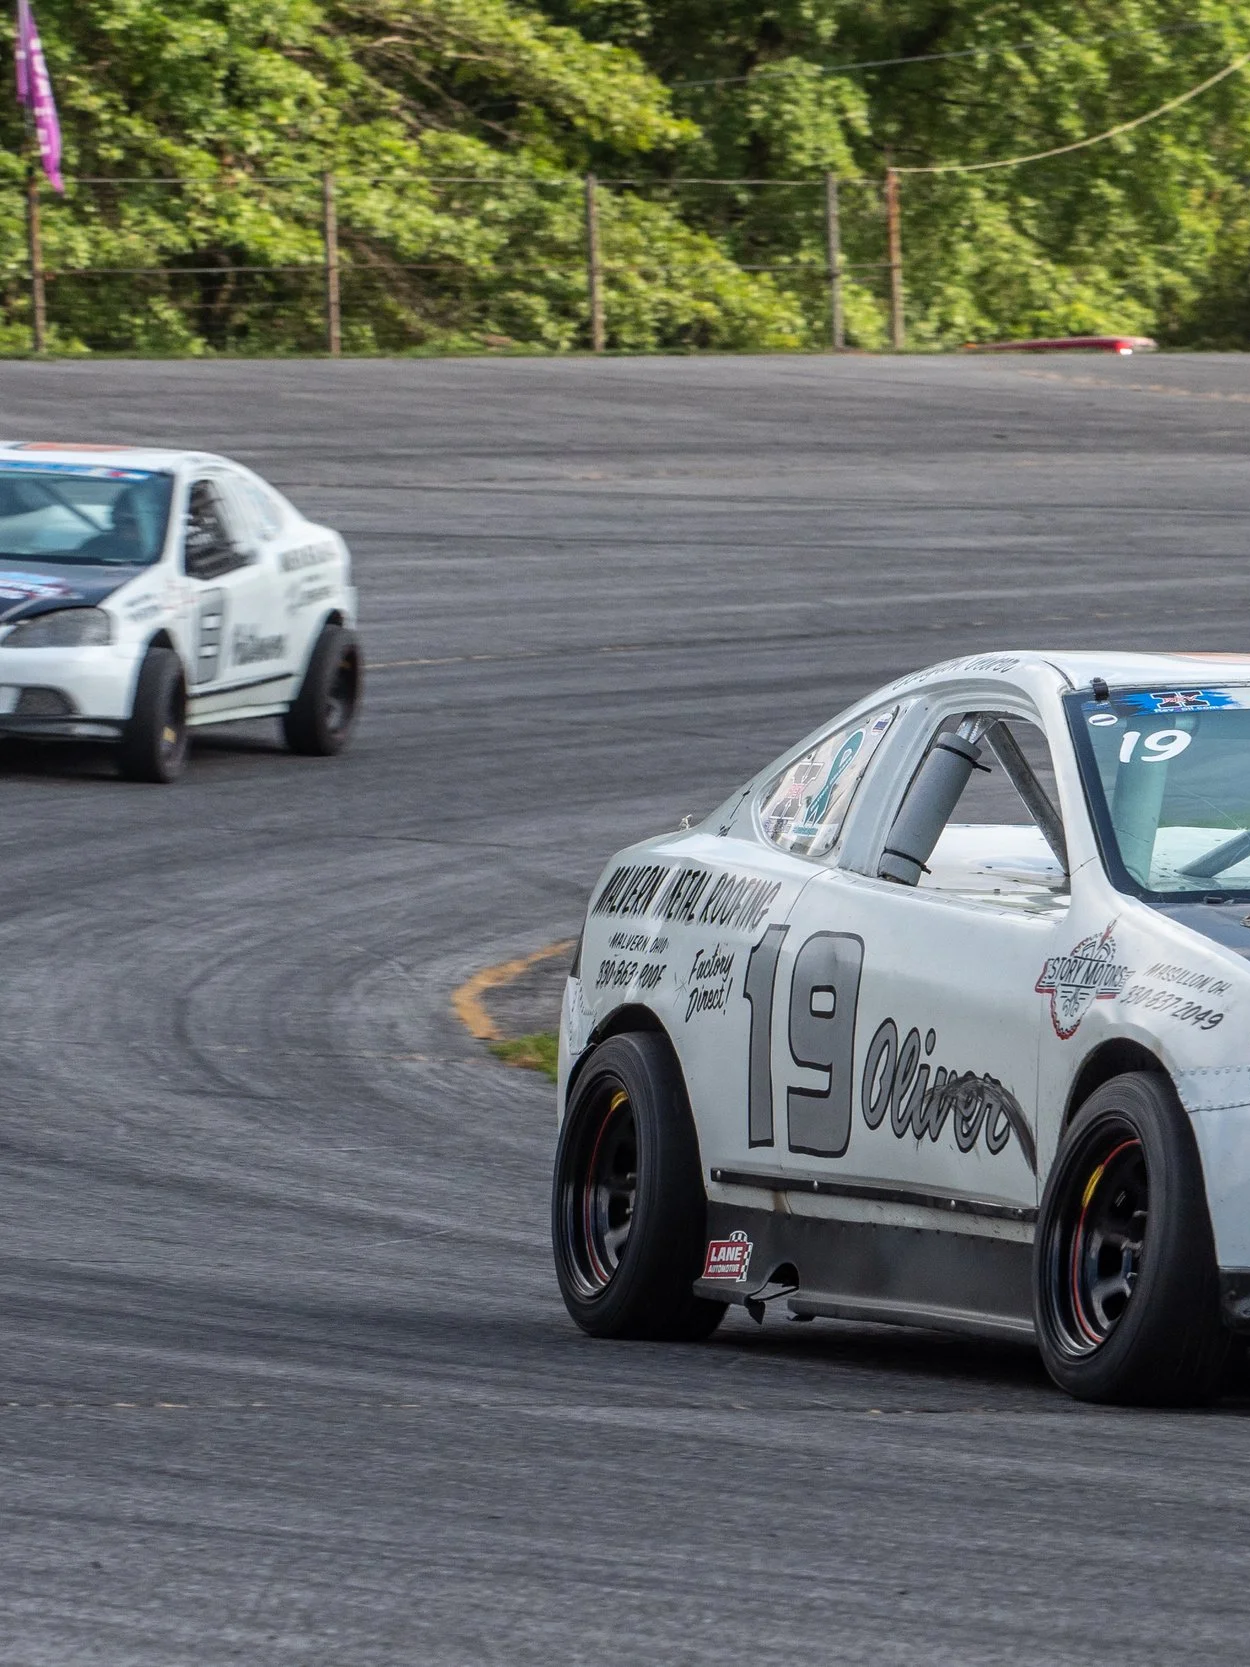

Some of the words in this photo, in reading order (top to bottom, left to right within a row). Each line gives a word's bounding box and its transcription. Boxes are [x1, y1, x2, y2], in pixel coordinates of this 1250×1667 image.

[1119, 729, 1192, 763] 19
[591, 865, 671, 917] MALVERN
[653, 868, 713, 922] METAL
[701, 872, 782, 931] ROOFING
[688, 943, 735, 985] Factory
[1081, 961, 1128, 988] MOTORS
[685, 977, 734, 1023] Direct!
[743, 924, 865, 1159] 19
[861, 1017, 1011, 1155] Oliver
[708, 1263, 740, 1273] AUTOMOTIVE
[710, 1246, 743, 1261] LANE
